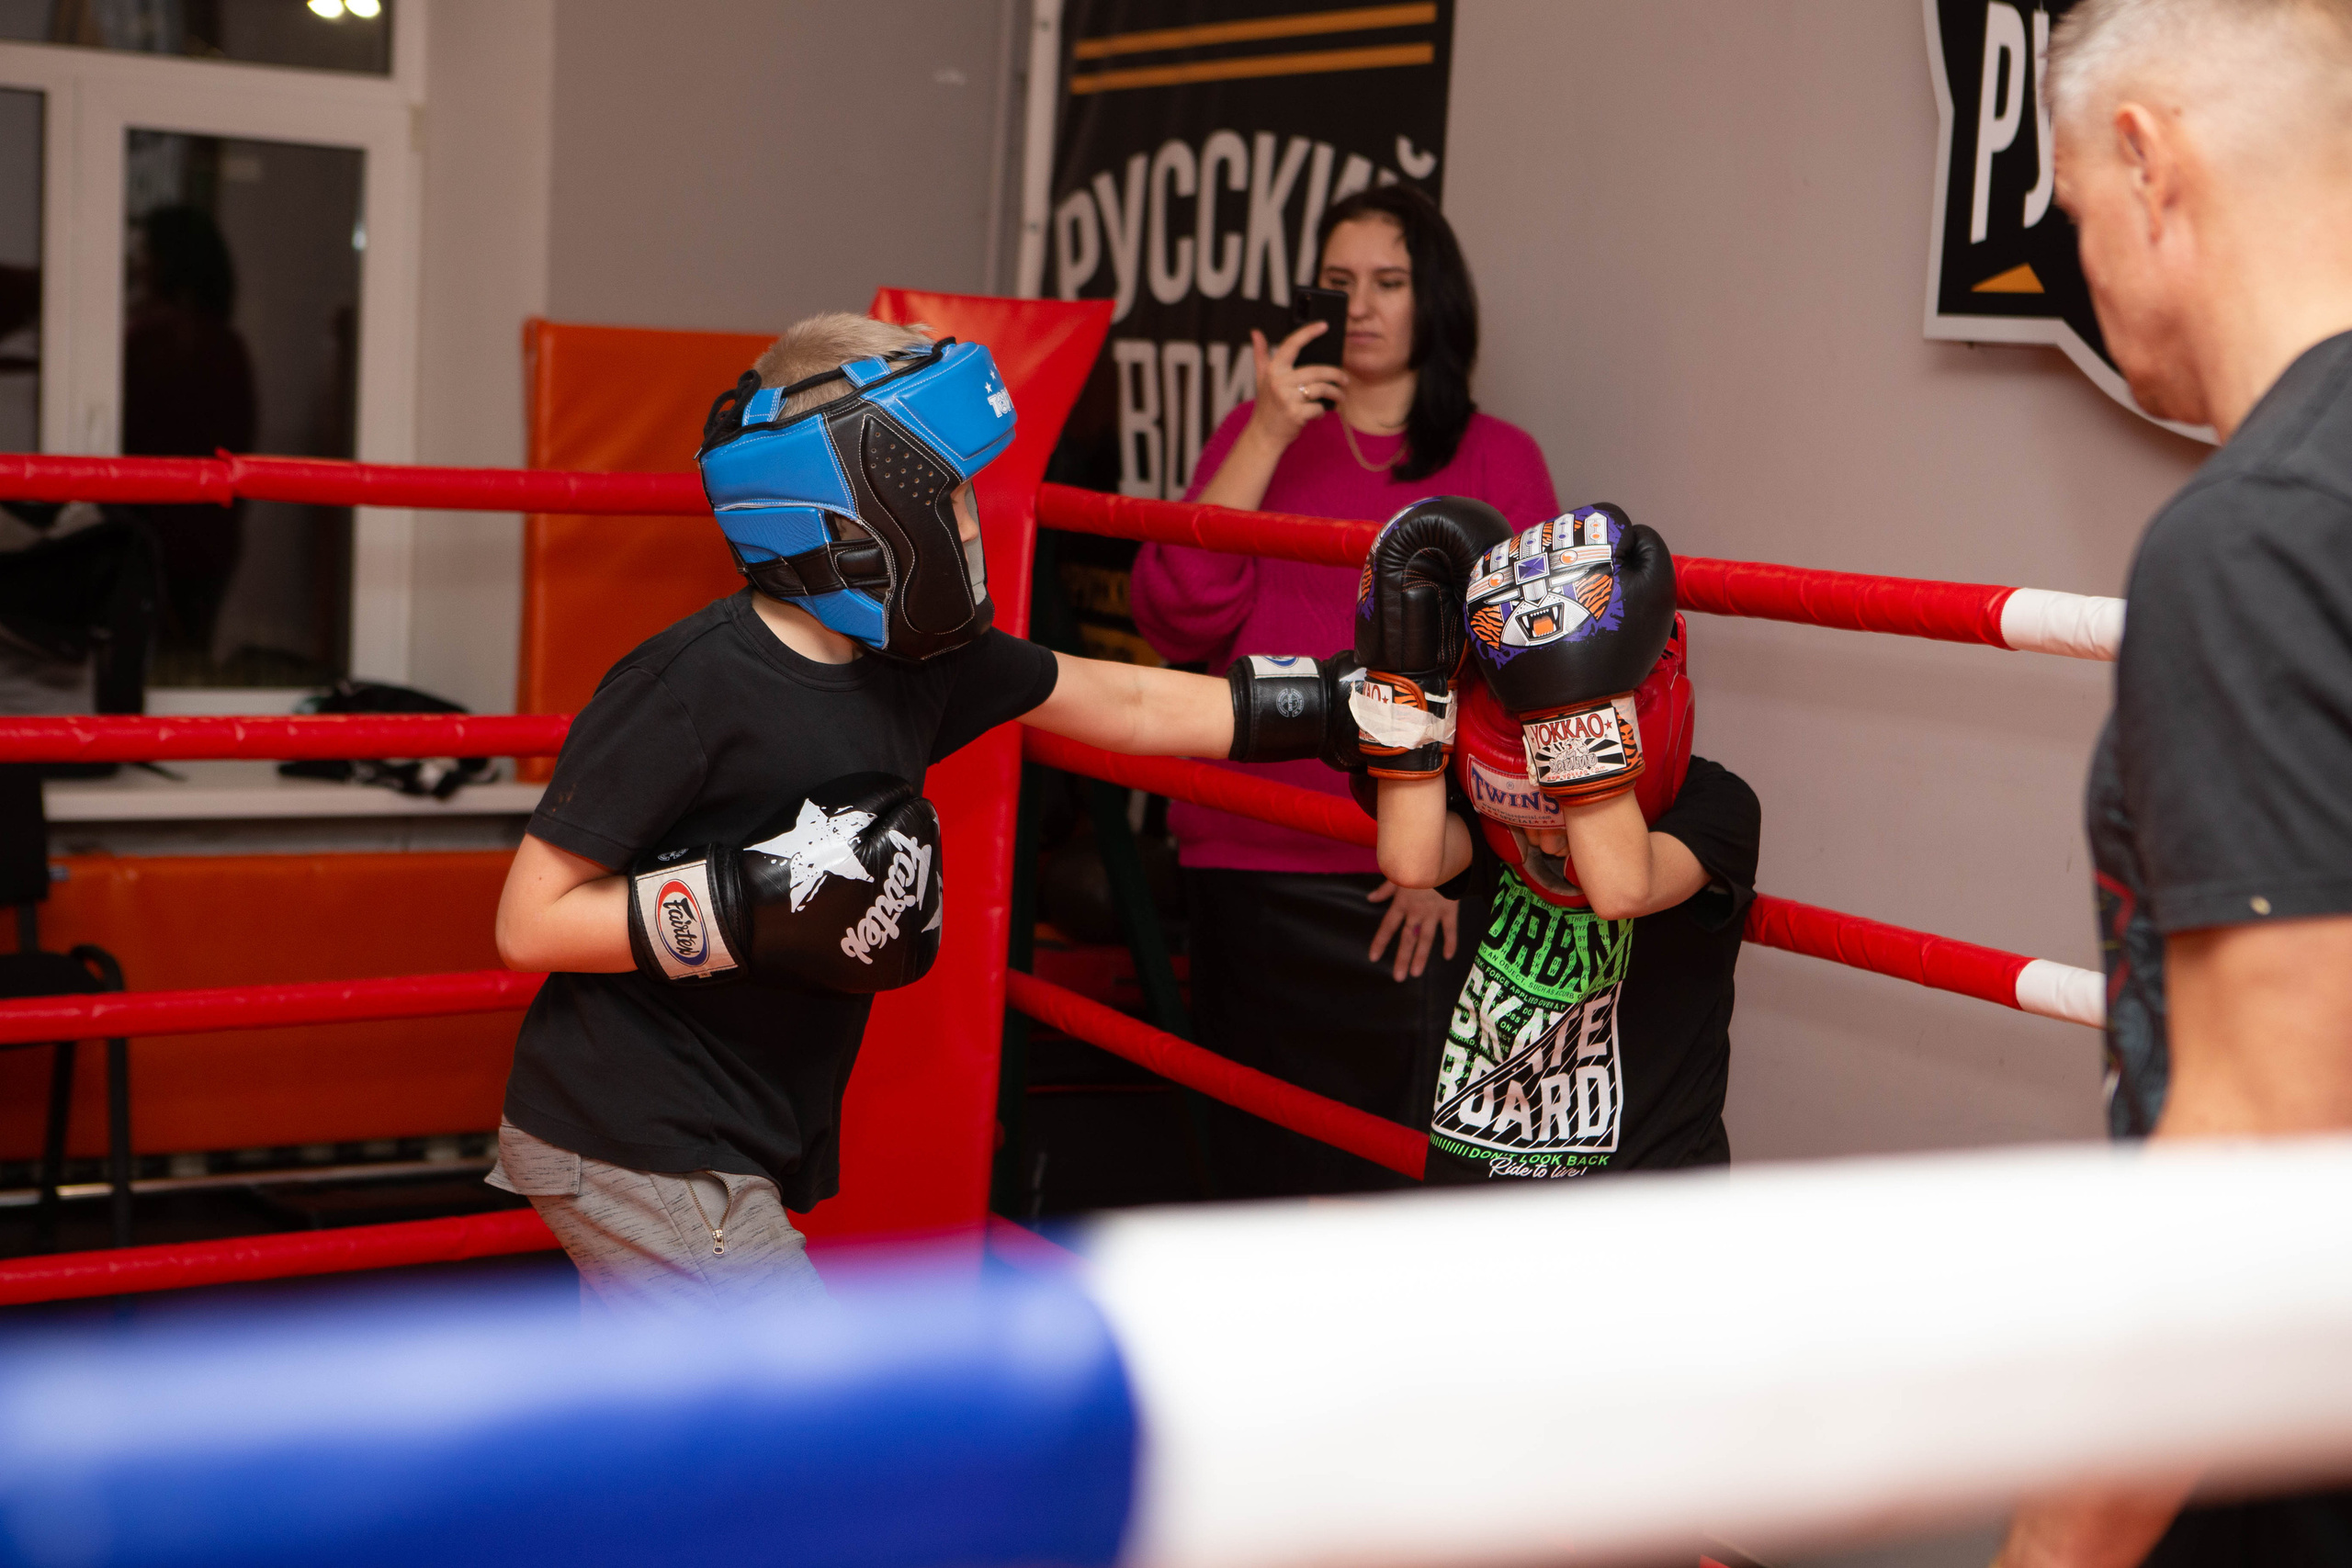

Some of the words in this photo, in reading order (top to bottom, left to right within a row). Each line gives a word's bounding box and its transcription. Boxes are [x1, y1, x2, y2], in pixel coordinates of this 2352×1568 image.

[1530, 713, 1604, 750] YOKKAO
[1472, 766, 1560, 815] TWINS
[662, 897, 699, 956] Fairtex
[1486, 966, 1510, 987] FORCE
[1510, 986, 1538, 1005] APPLIED
[1538, 999, 1554, 1010] OVER
[1499, 960, 1526, 986] OBJECT,
[1529, 982, 1547, 994] SUCH
[1451, 964, 1612, 1075] SKATE
[1500, 1021, 1512, 1032] ON
[1522, 1007, 1533, 1016] DO
[1434, 1039, 1611, 1142] BOARD
[1468, 1147, 1518, 1161] DON'T
[1519, 1154, 1563, 1166] LOOK
[1566, 1155, 1611, 1167] BACK
[1488, 1156, 1532, 1179] Ride
[1532, 1163, 1548, 1179] to
